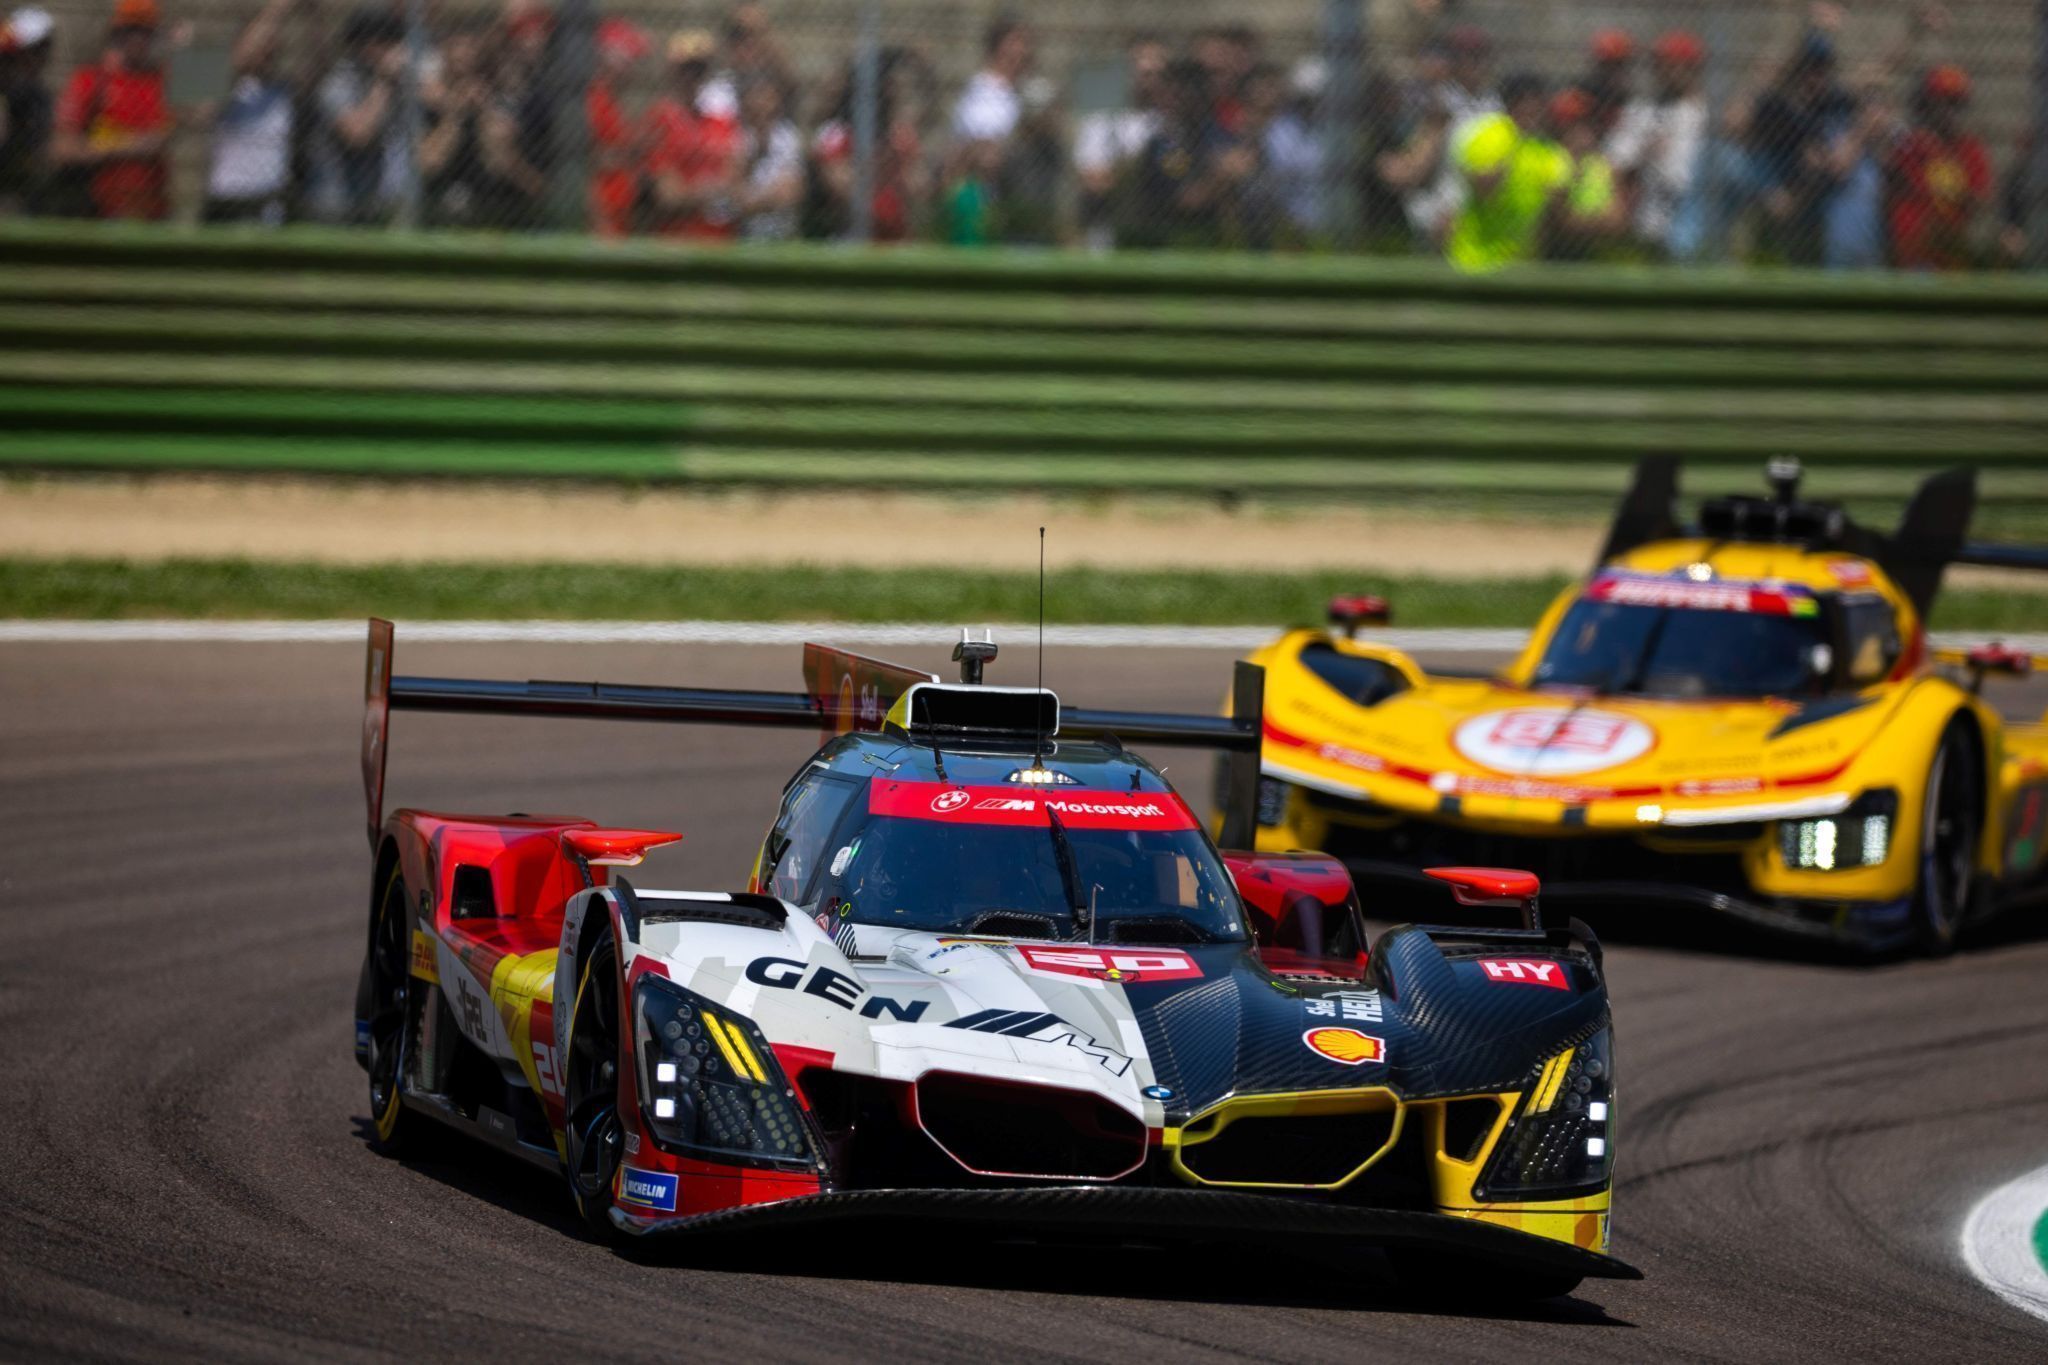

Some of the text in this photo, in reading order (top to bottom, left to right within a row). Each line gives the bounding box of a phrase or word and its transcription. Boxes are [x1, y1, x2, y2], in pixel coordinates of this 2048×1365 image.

[1045, 800, 1166, 818] Motorsport
[1027, 950, 1190, 970] 20
[1485, 962, 1555, 982] HY
[745, 956, 931, 1023] GEN
[628, 1180, 667, 1198] MICHELIN
